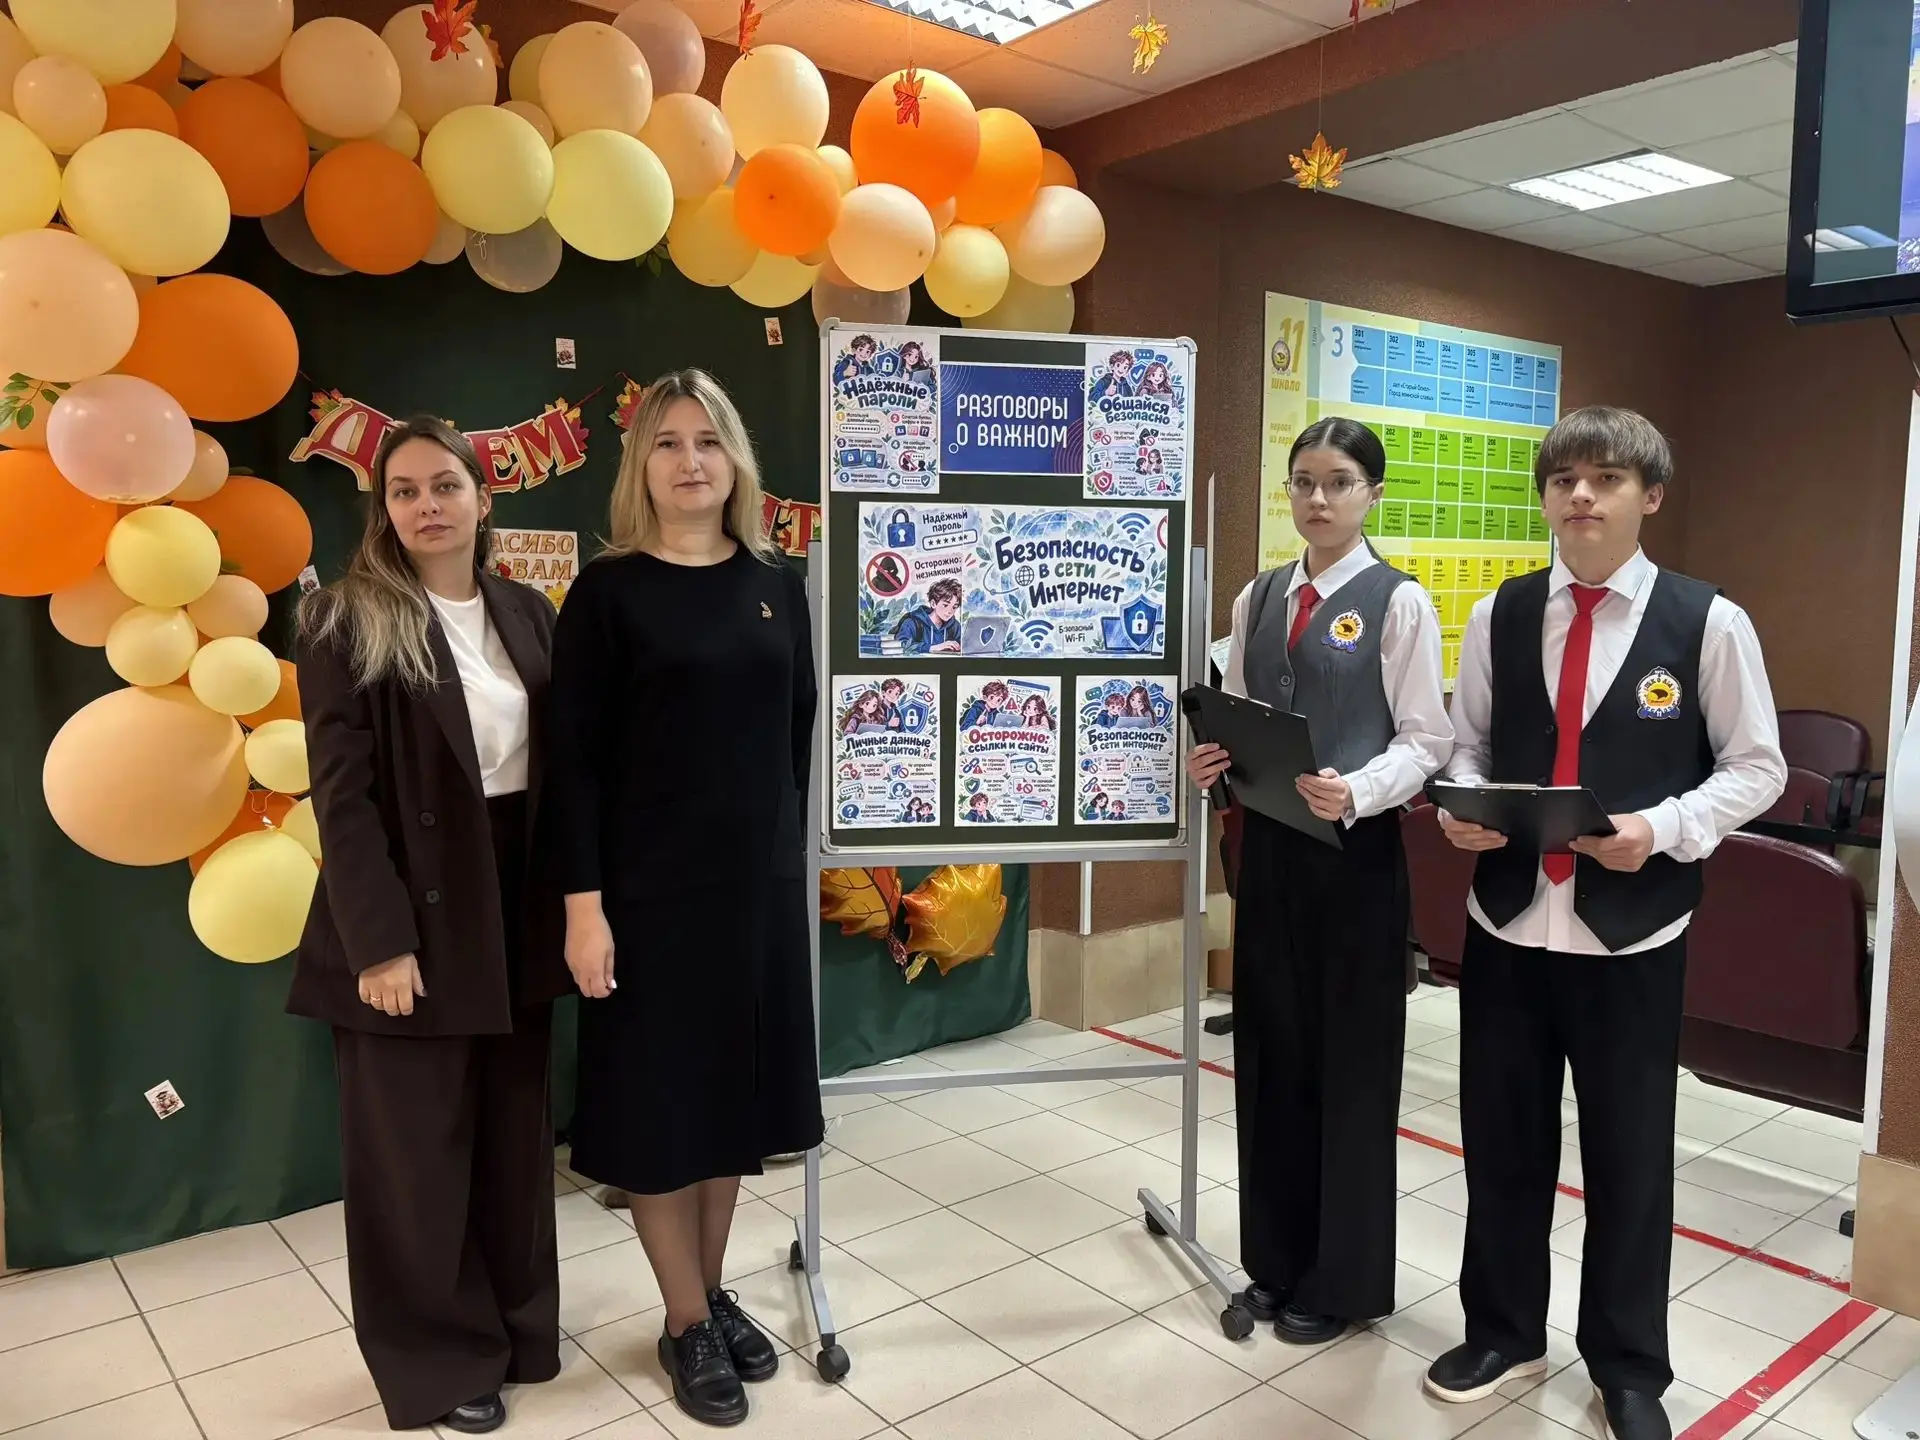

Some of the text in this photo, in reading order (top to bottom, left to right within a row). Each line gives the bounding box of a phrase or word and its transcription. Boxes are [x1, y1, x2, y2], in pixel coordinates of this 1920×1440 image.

[1354, 329, 1364, 338] 301
[1389, 335, 1399, 344] 302
[1330, 325, 1344, 358] 3
[1416, 340, 1425, 348] 303
[1442, 344, 1451, 352] 304
[1467, 348, 1476, 357] 305
[843, 377, 928, 399] Надёжные
[858, 395, 917, 409] пароли
[956, 394, 1069, 420] РАЗГОВОРЫ
[1100, 397, 1170, 415] Общайся
[957, 423, 1067, 448] О ВАЖНОМ
[1385, 428, 1395, 436] 202
[289, 397, 587, 493] ДЕМ
[932, 523, 961, 533] пароль
[995, 536, 1145, 573] Безопасность
[1039, 562, 1096, 579] в сети
[1029, 582, 1125, 608] Интернет
[1065, 633, 1085, 642] Wi-Fi
[969, 729, 1049, 744] Осторожно:
[1087, 729, 1168, 746] Безопасность
[846, 736, 930, 752] Личные данные
[968, 742, 1049, 753] ссылки и сайты
[1092, 740, 1163, 752] в сети интернет
[855, 746, 921, 758] под защитой
